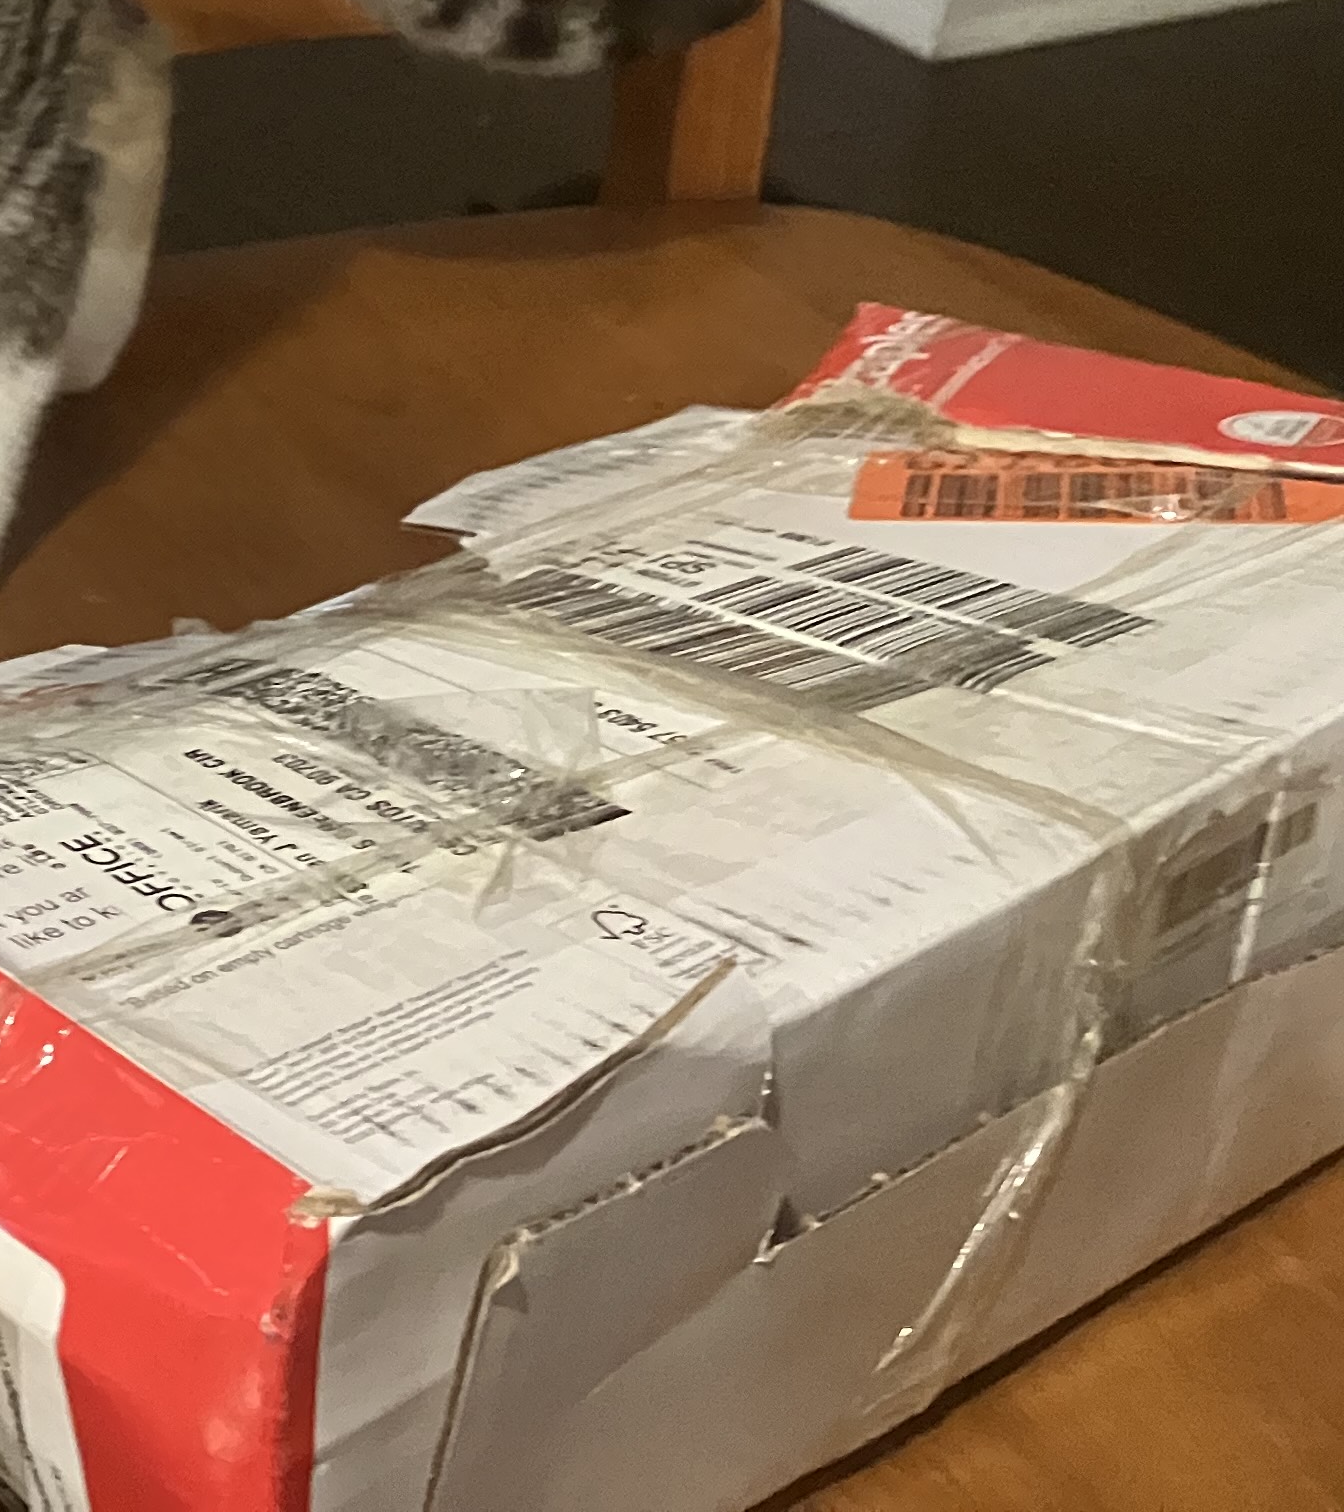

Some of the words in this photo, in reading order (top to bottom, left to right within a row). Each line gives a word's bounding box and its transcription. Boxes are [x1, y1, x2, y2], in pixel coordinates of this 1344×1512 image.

[335, 783, 372, 802] CA
[57, 833, 198, 913] OFFICE
[4, 898, 60, 924] you
[7, 926, 65, 950] like
[61, 915, 96, 931] to
